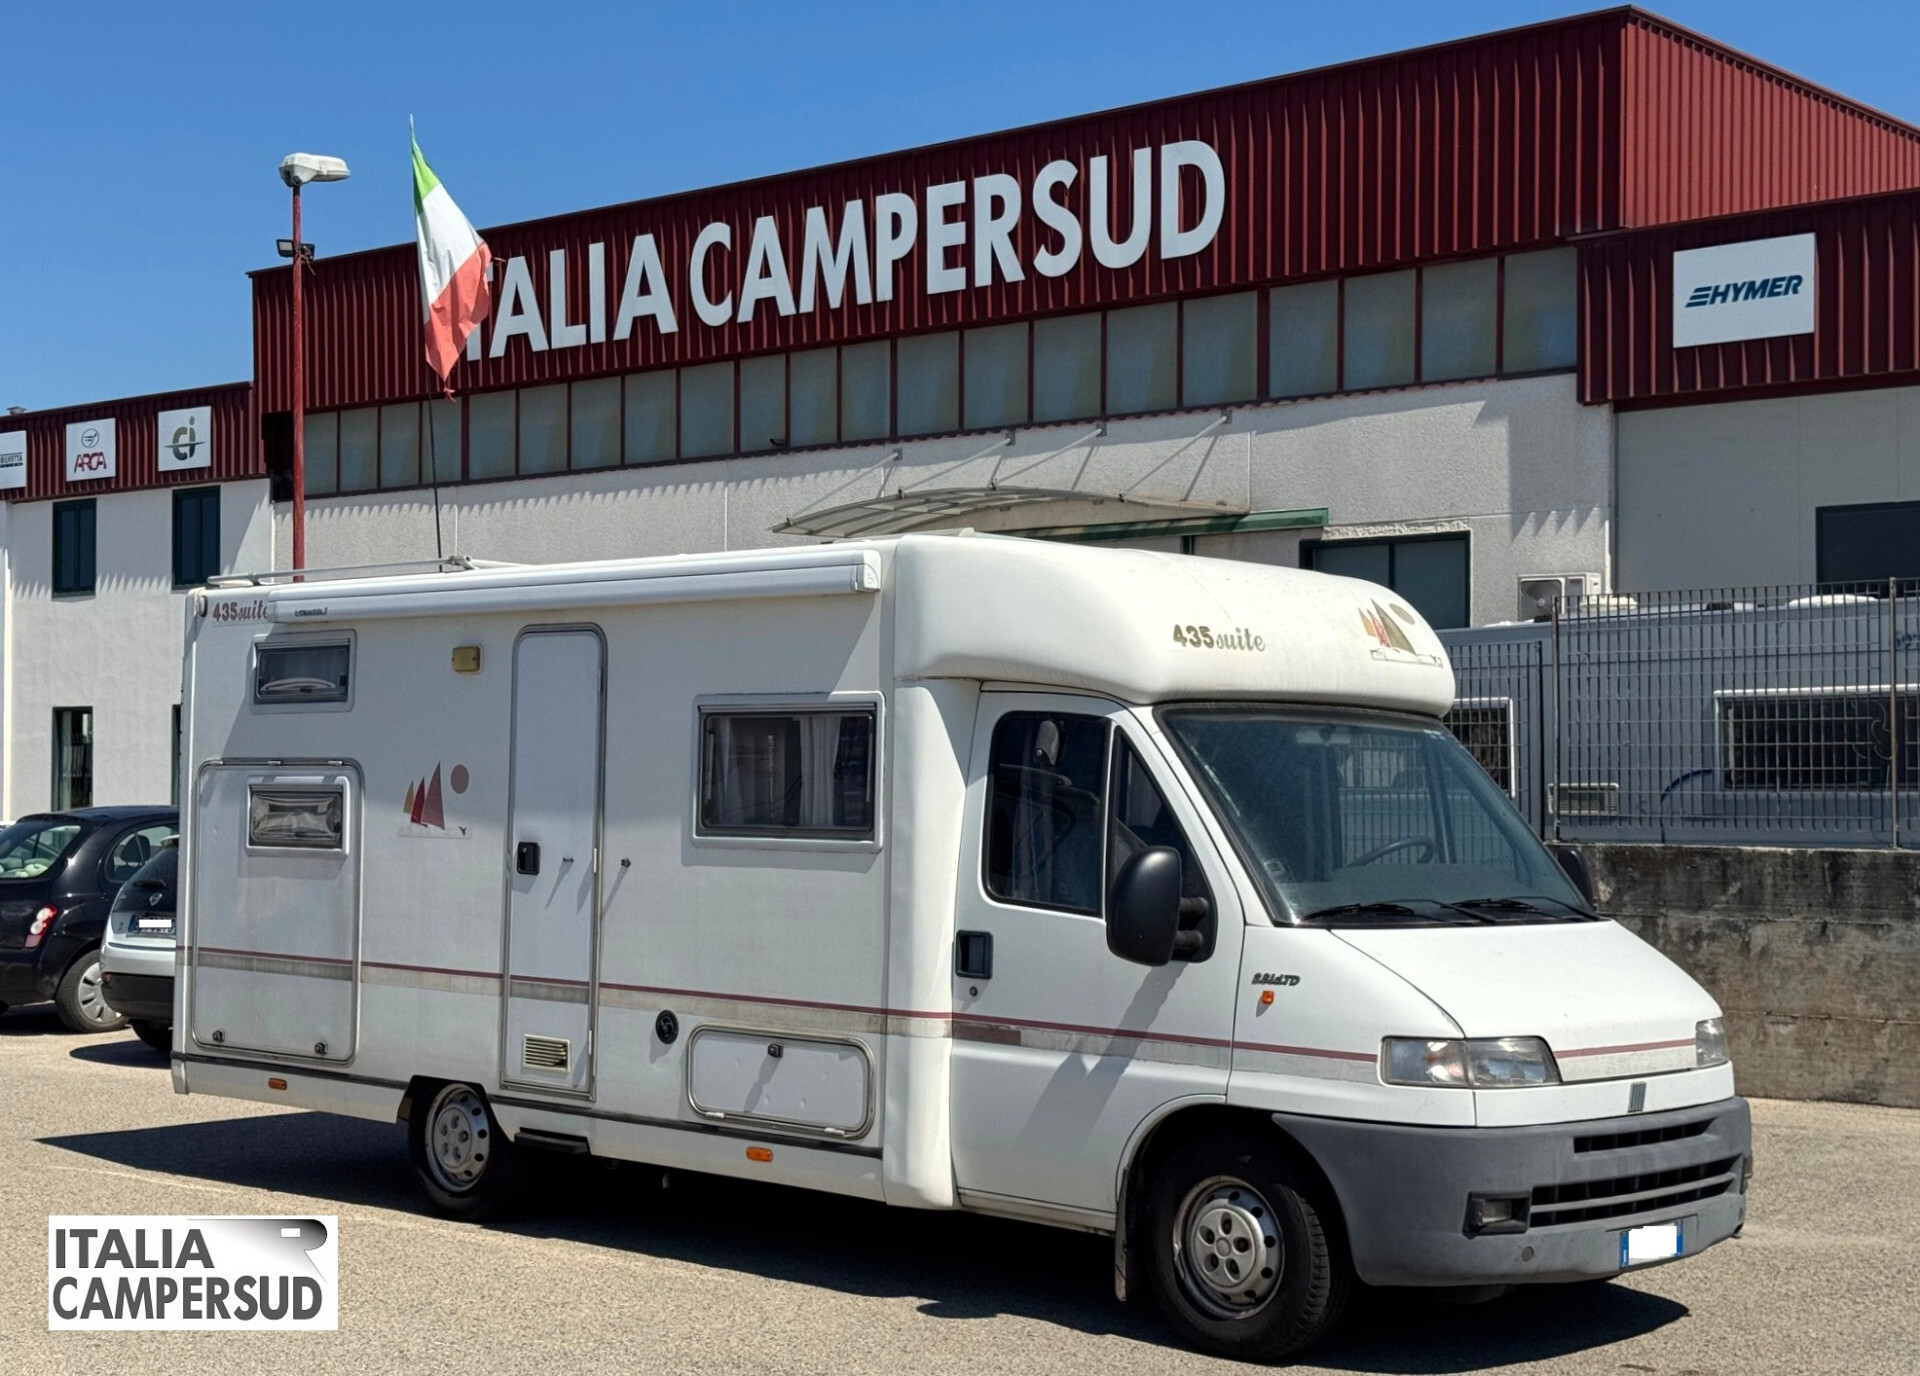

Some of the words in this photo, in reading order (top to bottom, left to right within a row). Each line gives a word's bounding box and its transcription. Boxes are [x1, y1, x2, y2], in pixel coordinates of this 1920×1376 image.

[466, 233, 679, 361] ALIA
[690, 140, 1226, 328] CAMPERSUD
[1708, 274, 1803, 306] HYMER
[73, 452, 107, 473] ARCA
